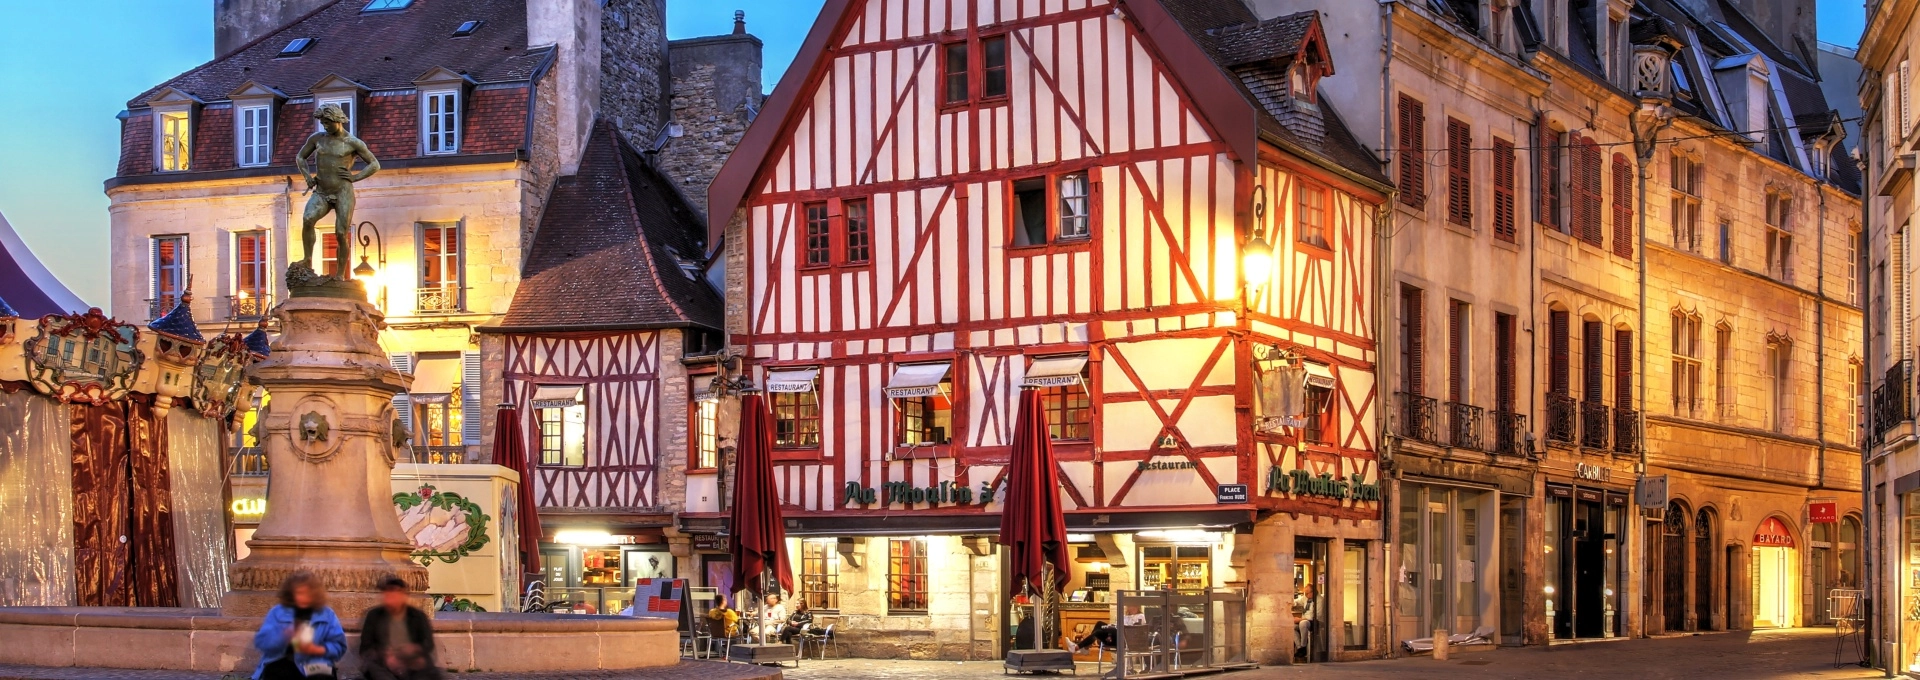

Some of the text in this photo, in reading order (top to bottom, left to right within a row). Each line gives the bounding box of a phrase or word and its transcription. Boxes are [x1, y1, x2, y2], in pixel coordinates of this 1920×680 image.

[1028, 376, 1076, 385] RESTAURANT
[770, 383, 808, 391] RESTAURANT
[890, 386, 934, 396] RESTAURANT
[535, 399, 574, 407] RESTAURANT
[1158, 436, 1177, 446] Bar
[1138, 460, 1198, 471] Restaurant
[1577, 462, 1611, 482] CARBILLET
[1268, 465, 1291, 493] Au
[1289, 469, 1342, 498] Moulin
[843, 481, 877, 504] Au
[882, 480, 972, 504] Moulin
[979, 481, 994, 503] à
[1760, 534, 1792, 544] BAYARD
